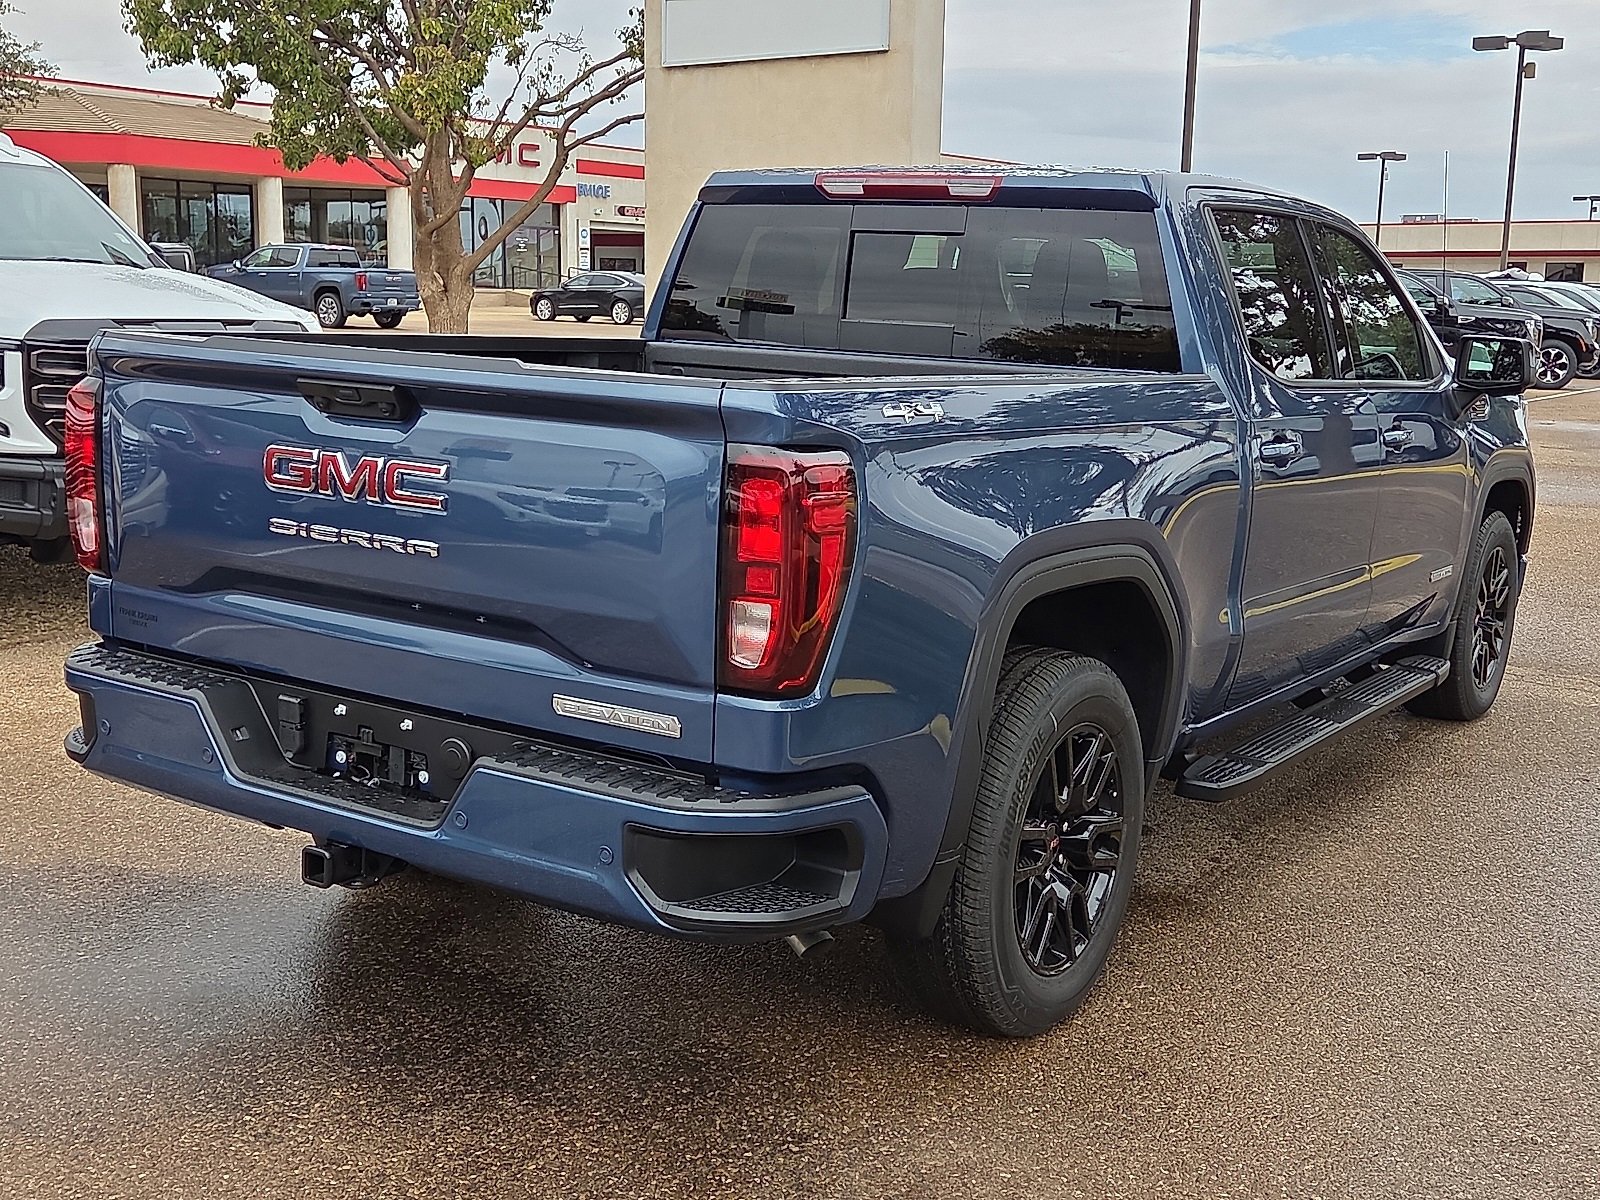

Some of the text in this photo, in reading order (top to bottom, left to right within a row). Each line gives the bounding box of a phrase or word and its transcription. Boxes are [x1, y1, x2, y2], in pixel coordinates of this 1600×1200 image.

[263, 443, 450, 511] GMC
[268, 516, 440, 558] SIERRA
[562, 700, 671, 731] ELEVATION
